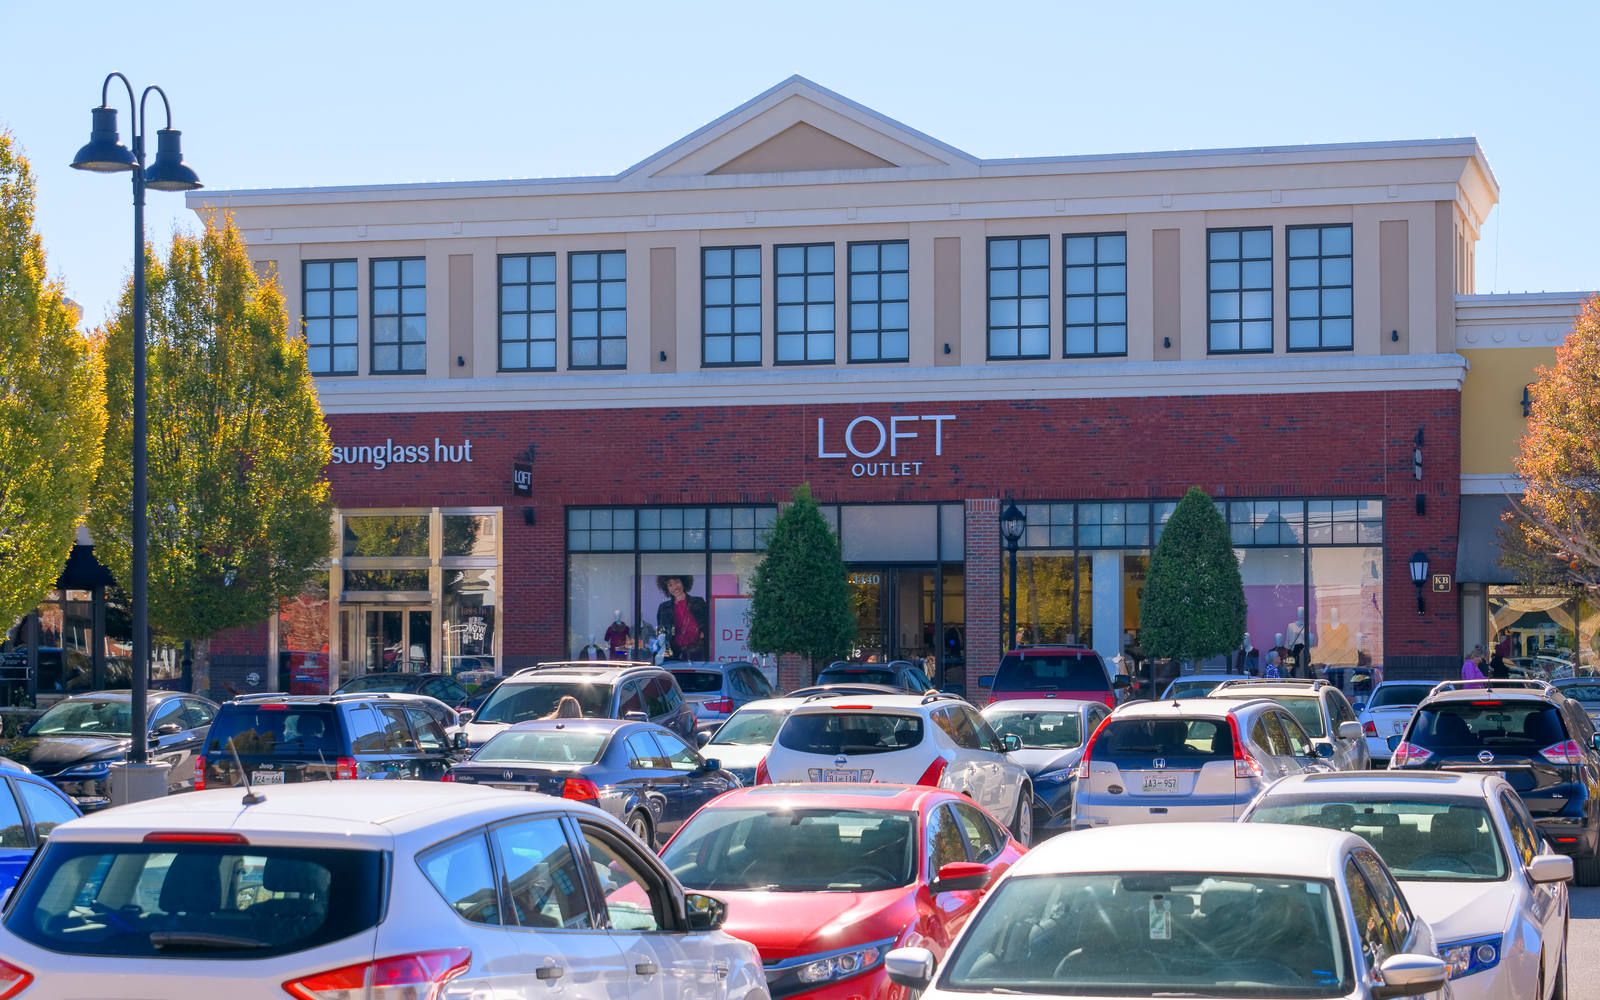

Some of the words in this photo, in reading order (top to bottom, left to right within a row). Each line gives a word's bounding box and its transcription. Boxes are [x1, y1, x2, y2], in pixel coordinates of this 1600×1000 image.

[818, 415, 957, 458] LOFT
[332, 438, 430, 470] sunglass
[434, 437, 473, 463] hut
[514, 470, 532, 485] LOFT
[851, 462, 923, 477] OUTLET
